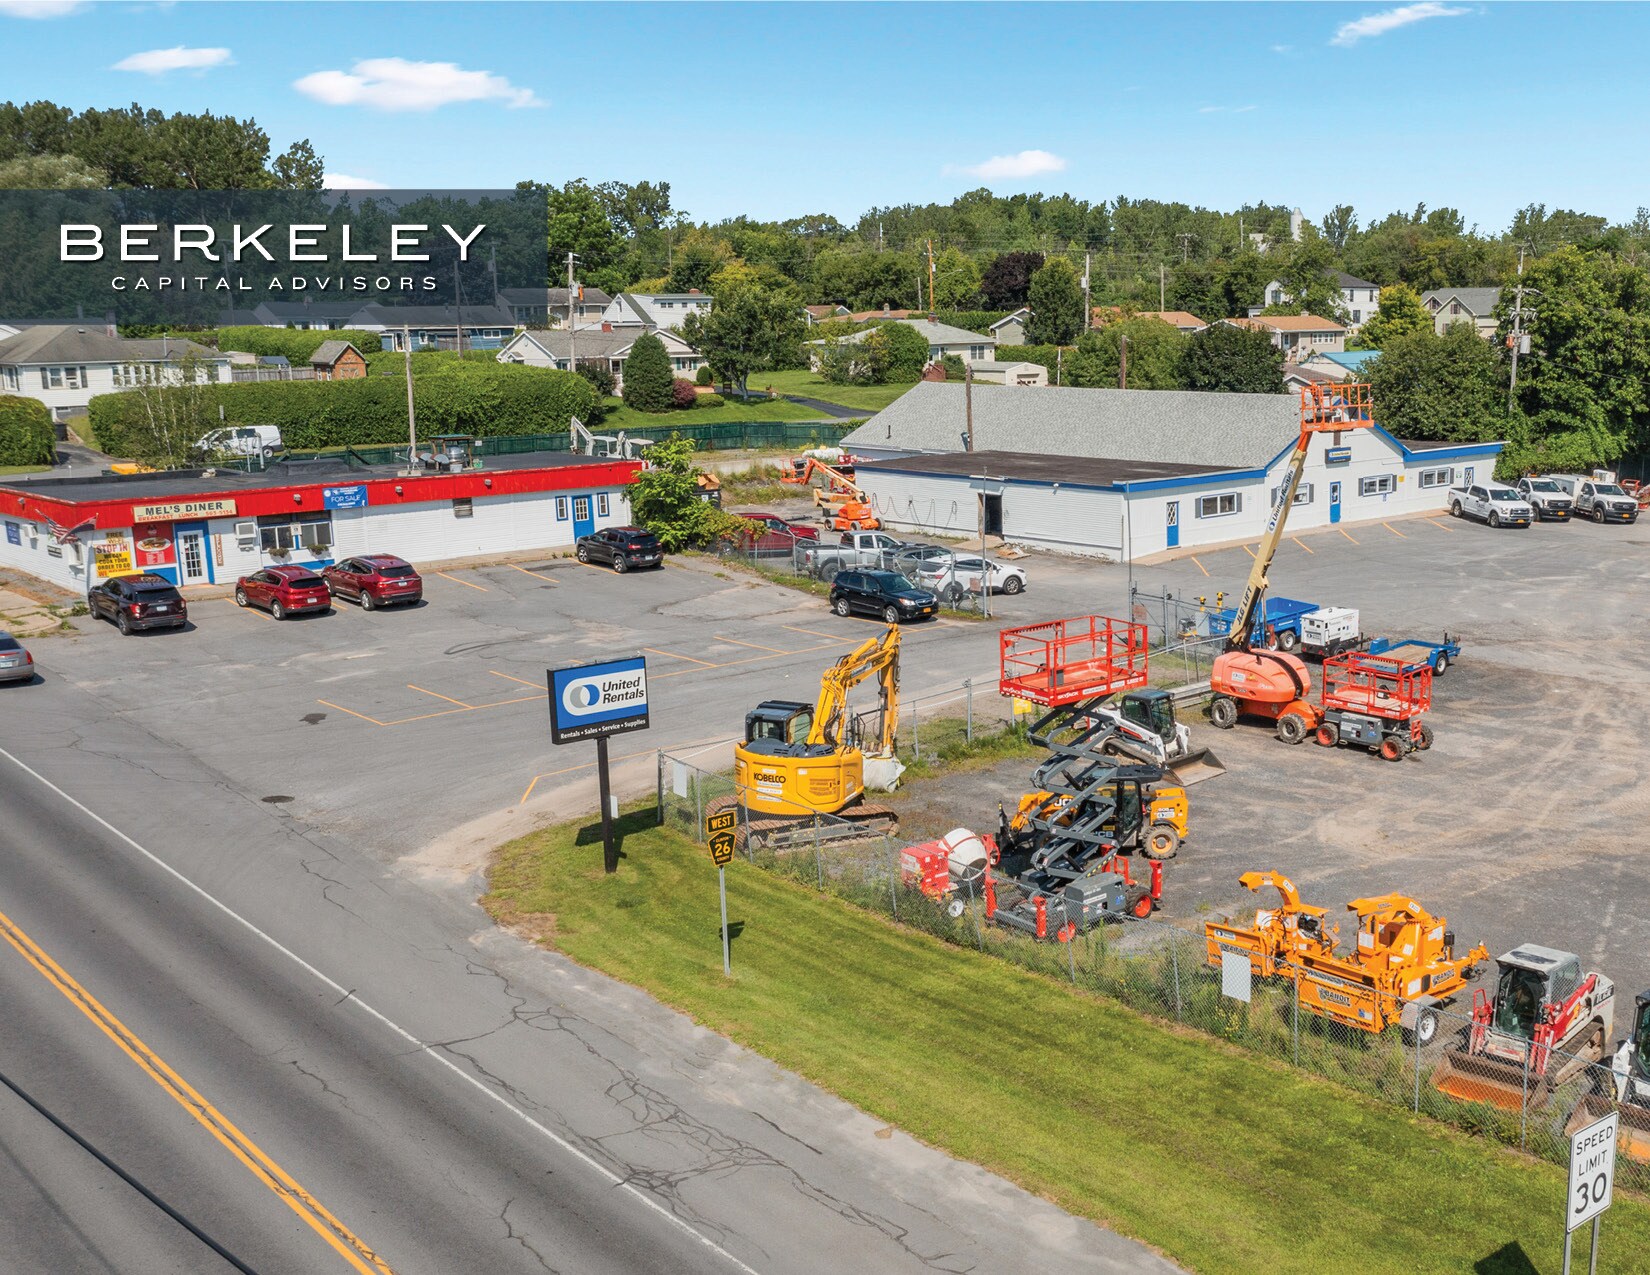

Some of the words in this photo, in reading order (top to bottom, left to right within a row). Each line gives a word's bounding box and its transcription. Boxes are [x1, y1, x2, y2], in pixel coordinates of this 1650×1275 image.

[1272, 496, 1285, 522] United
[1281, 469, 1294, 498] Rentals
[145, 504, 180, 516] MEL'S
[185, 502, 223, 512] DINER
[96, 544, 119, 554] STOP
[120, 543, 128, 552] IN
[1236, 607, 1246, 625] JLG
[1242, 586, 1252, 607] LIFT
[602, 677, 641, 693] United
[602, 688, 644, 704] Rentals
[560, 730, 580, 739] Rentals
[584, 727, 598, 735] Sales
[601, 723, 620, 732] Service
[624, 719, 646, 728] Supplies
[753, 772, 786, 784] KOBELCO
[711, 816, 731, 829] WEST
[715, 842, 730, 857] 26
[1325, 990, 1350, 1003] BANDIT
[1576, 1126, 1613, 1155] SPEED
[1578, 1149, 1608, 1176] LIMIT
[1575, 1172, 1607, 1214] 30
